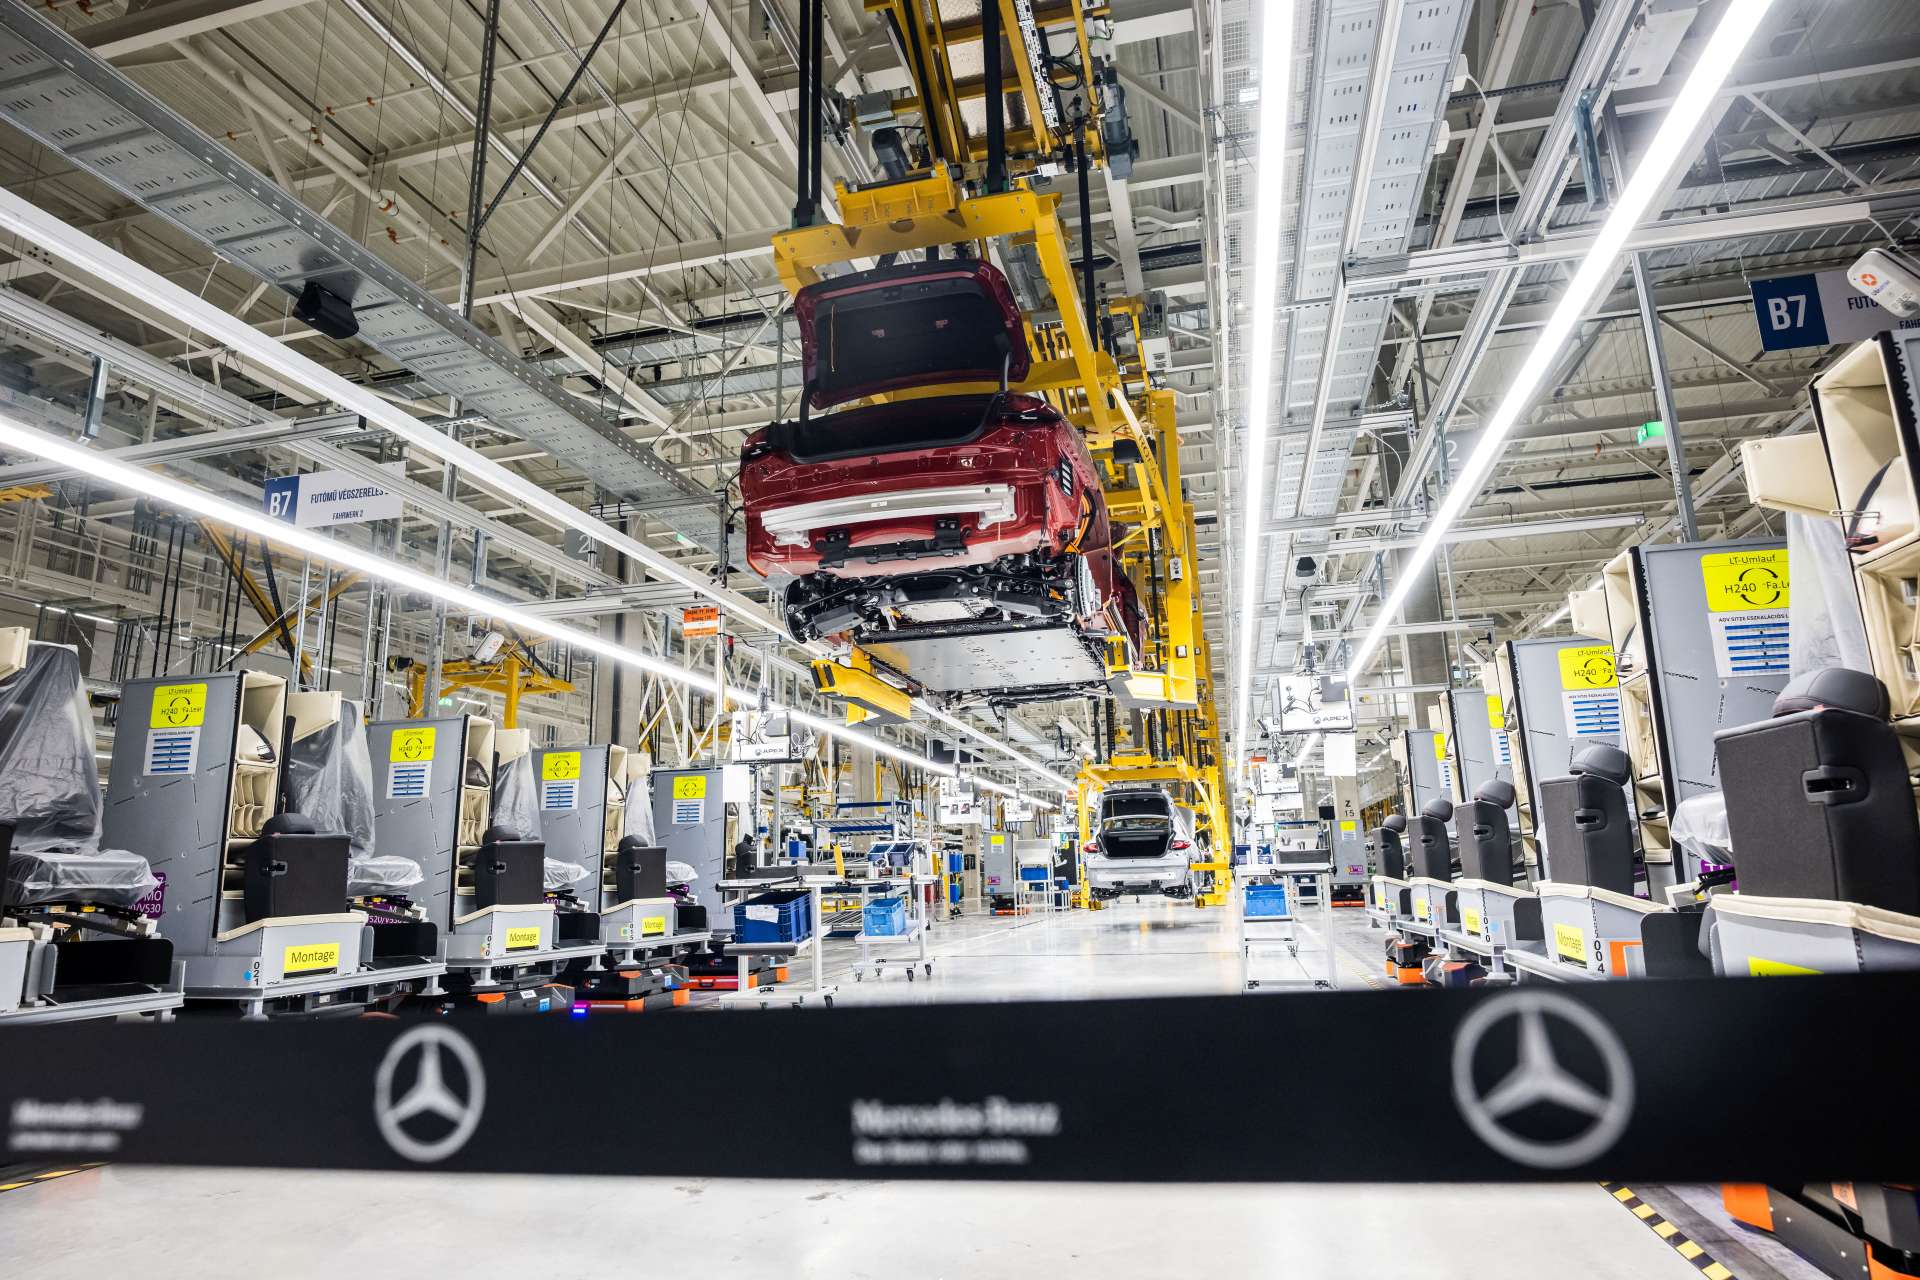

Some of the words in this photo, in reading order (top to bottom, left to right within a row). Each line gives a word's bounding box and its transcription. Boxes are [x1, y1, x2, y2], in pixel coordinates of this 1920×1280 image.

[1767, 294, 1807, 331] B7
[269, 490, 292, 517] B7
[332, 510, 359, 520] FAHRWERK
[1729, 554, 1776, 565] LT-Umlauf
[1724, 582, 1757, 594] H240
[1573, 668, 1597, 677] H240
[160, 707, 179, 716] H240
[1345, 799, 1351, 807] Z
[1344, 809, 1355, 817] 15
[508, 931, 537, 943] Montage
[291, 950, 335, 965] Montage
